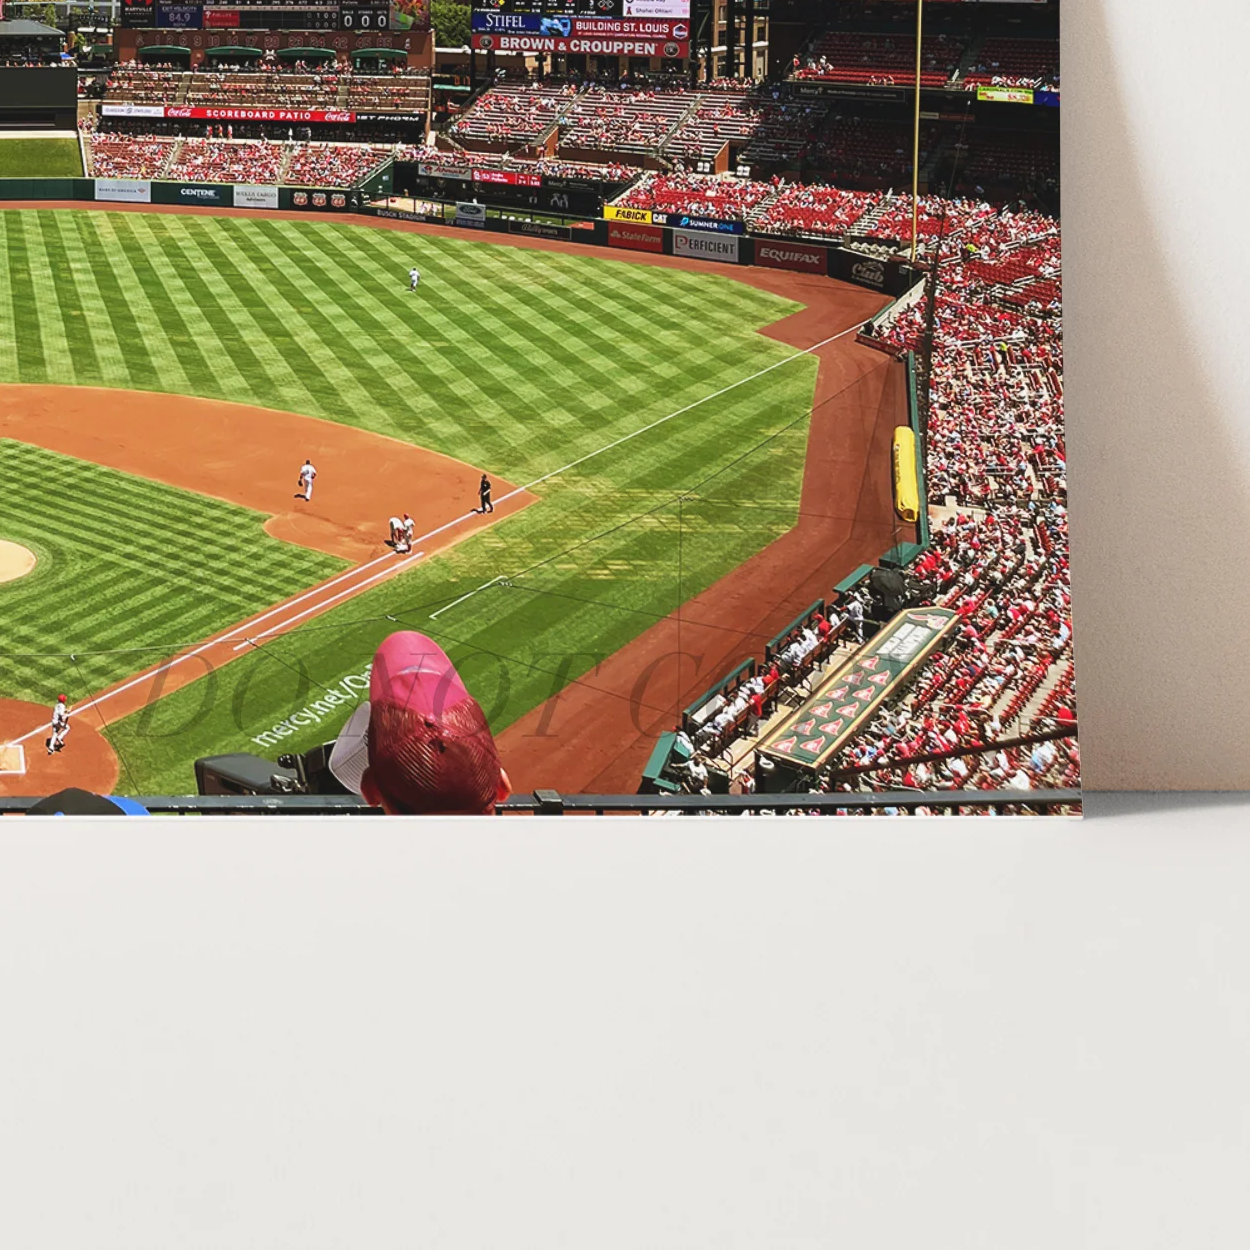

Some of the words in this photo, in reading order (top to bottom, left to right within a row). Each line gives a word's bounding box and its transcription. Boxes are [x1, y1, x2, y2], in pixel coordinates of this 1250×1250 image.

[344, 15, 353, 27] 0
[361, 15, 370, 27] 0
[377, 15, 387, 27] 0
[486, 13, 526, 28] STIFEL
[576, 20, 621, 32] BUILDING
[623, 22, 638, 32] ST.
[639, 23, 669, 33] LOUIS
[500, 36, 554, 50] BROWN
[557, 41, 567, 51] &
[569, 39, 656, 55] CROUPPEN
[206, 109, 276, 120] SCOREBOARD
[280, 111, 311, 121] PATIO
[180, 188, 216, 197] CENTENE
[377, 209, 398, 218] BUSCH
[398, 212, 427, 222] STADIUM
[615, 209, 647, 221] FABICK
[652, 213, 668, 224] CAT
[675, 235, 735, 254] PERFICIENT
[759, 247, 820, 264] EQUIFAX
[251, 664, 372, 747] mercy.net/O
